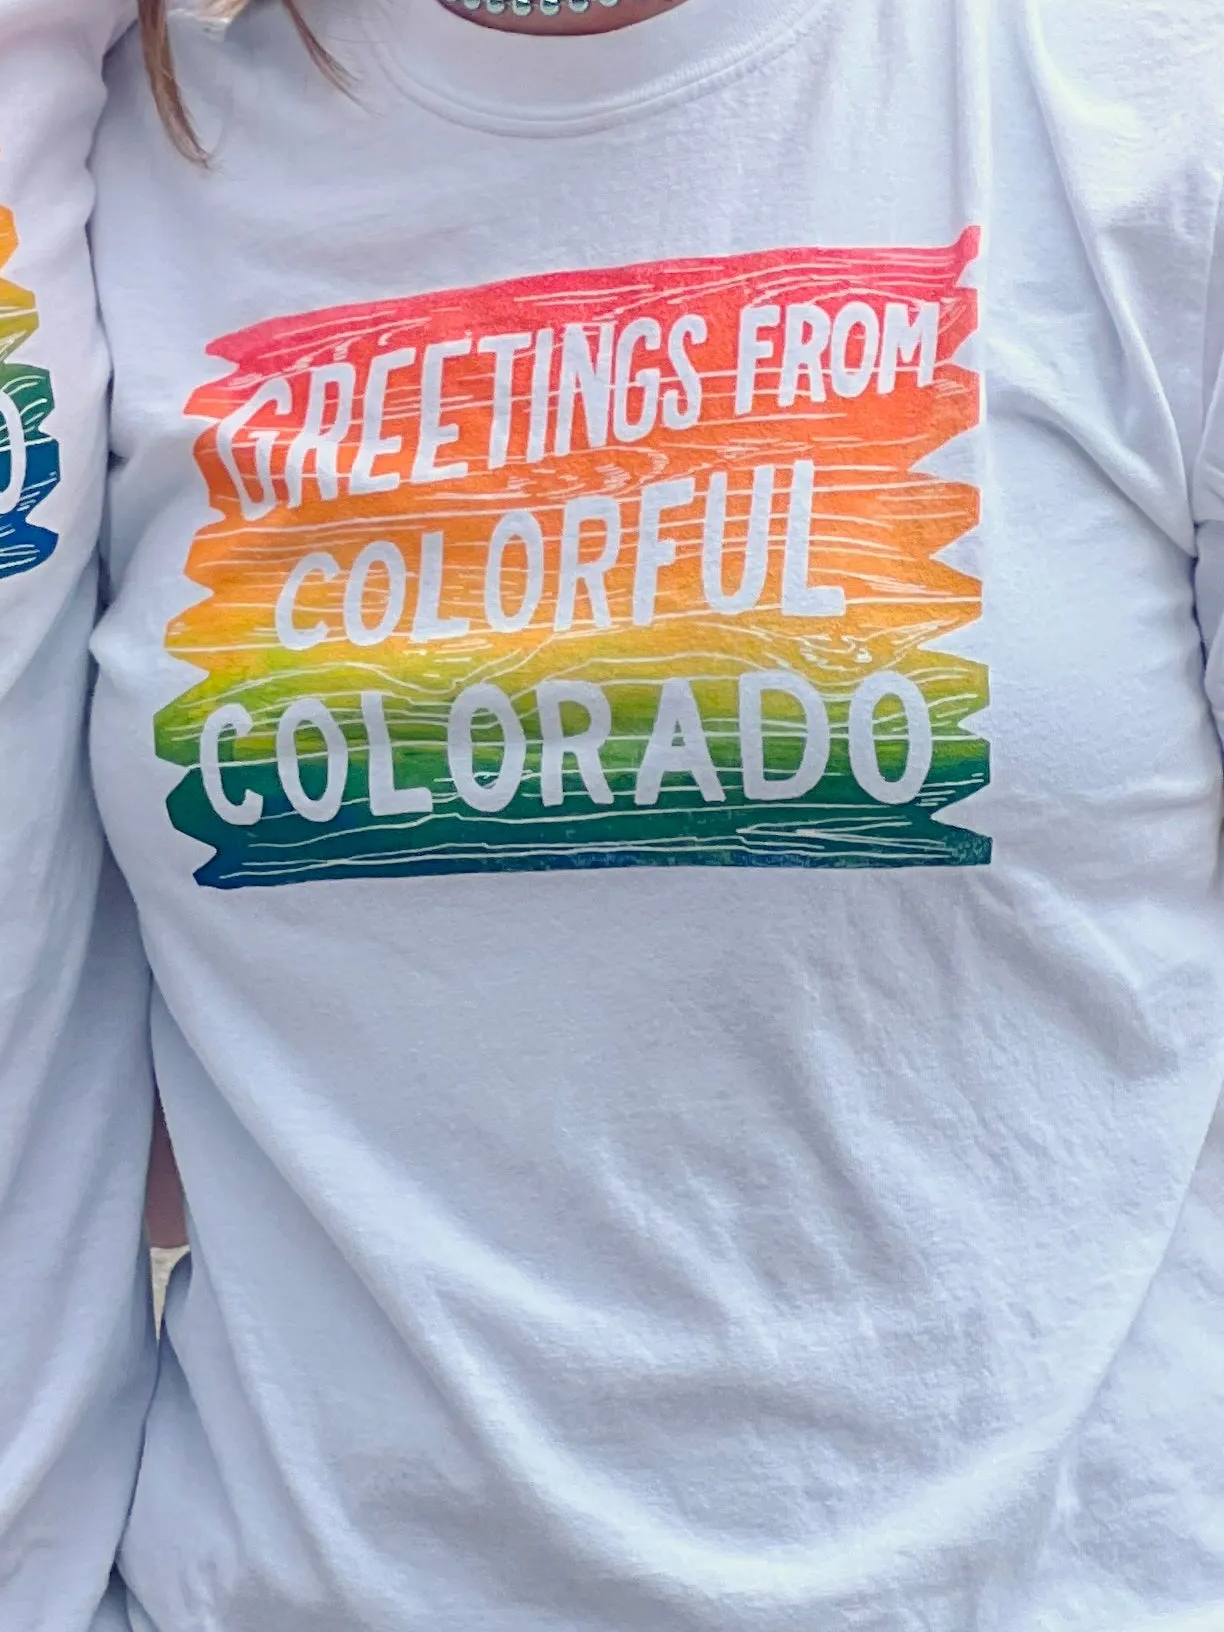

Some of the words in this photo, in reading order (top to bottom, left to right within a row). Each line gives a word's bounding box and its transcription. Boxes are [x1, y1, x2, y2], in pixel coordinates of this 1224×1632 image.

[215, 314, 705, 522] GREETINGS
[736, 300, 941, 415] FROM
[274, 459, 847, 651] COLORFUL
[199, 669, 934, 827] COLORADO
